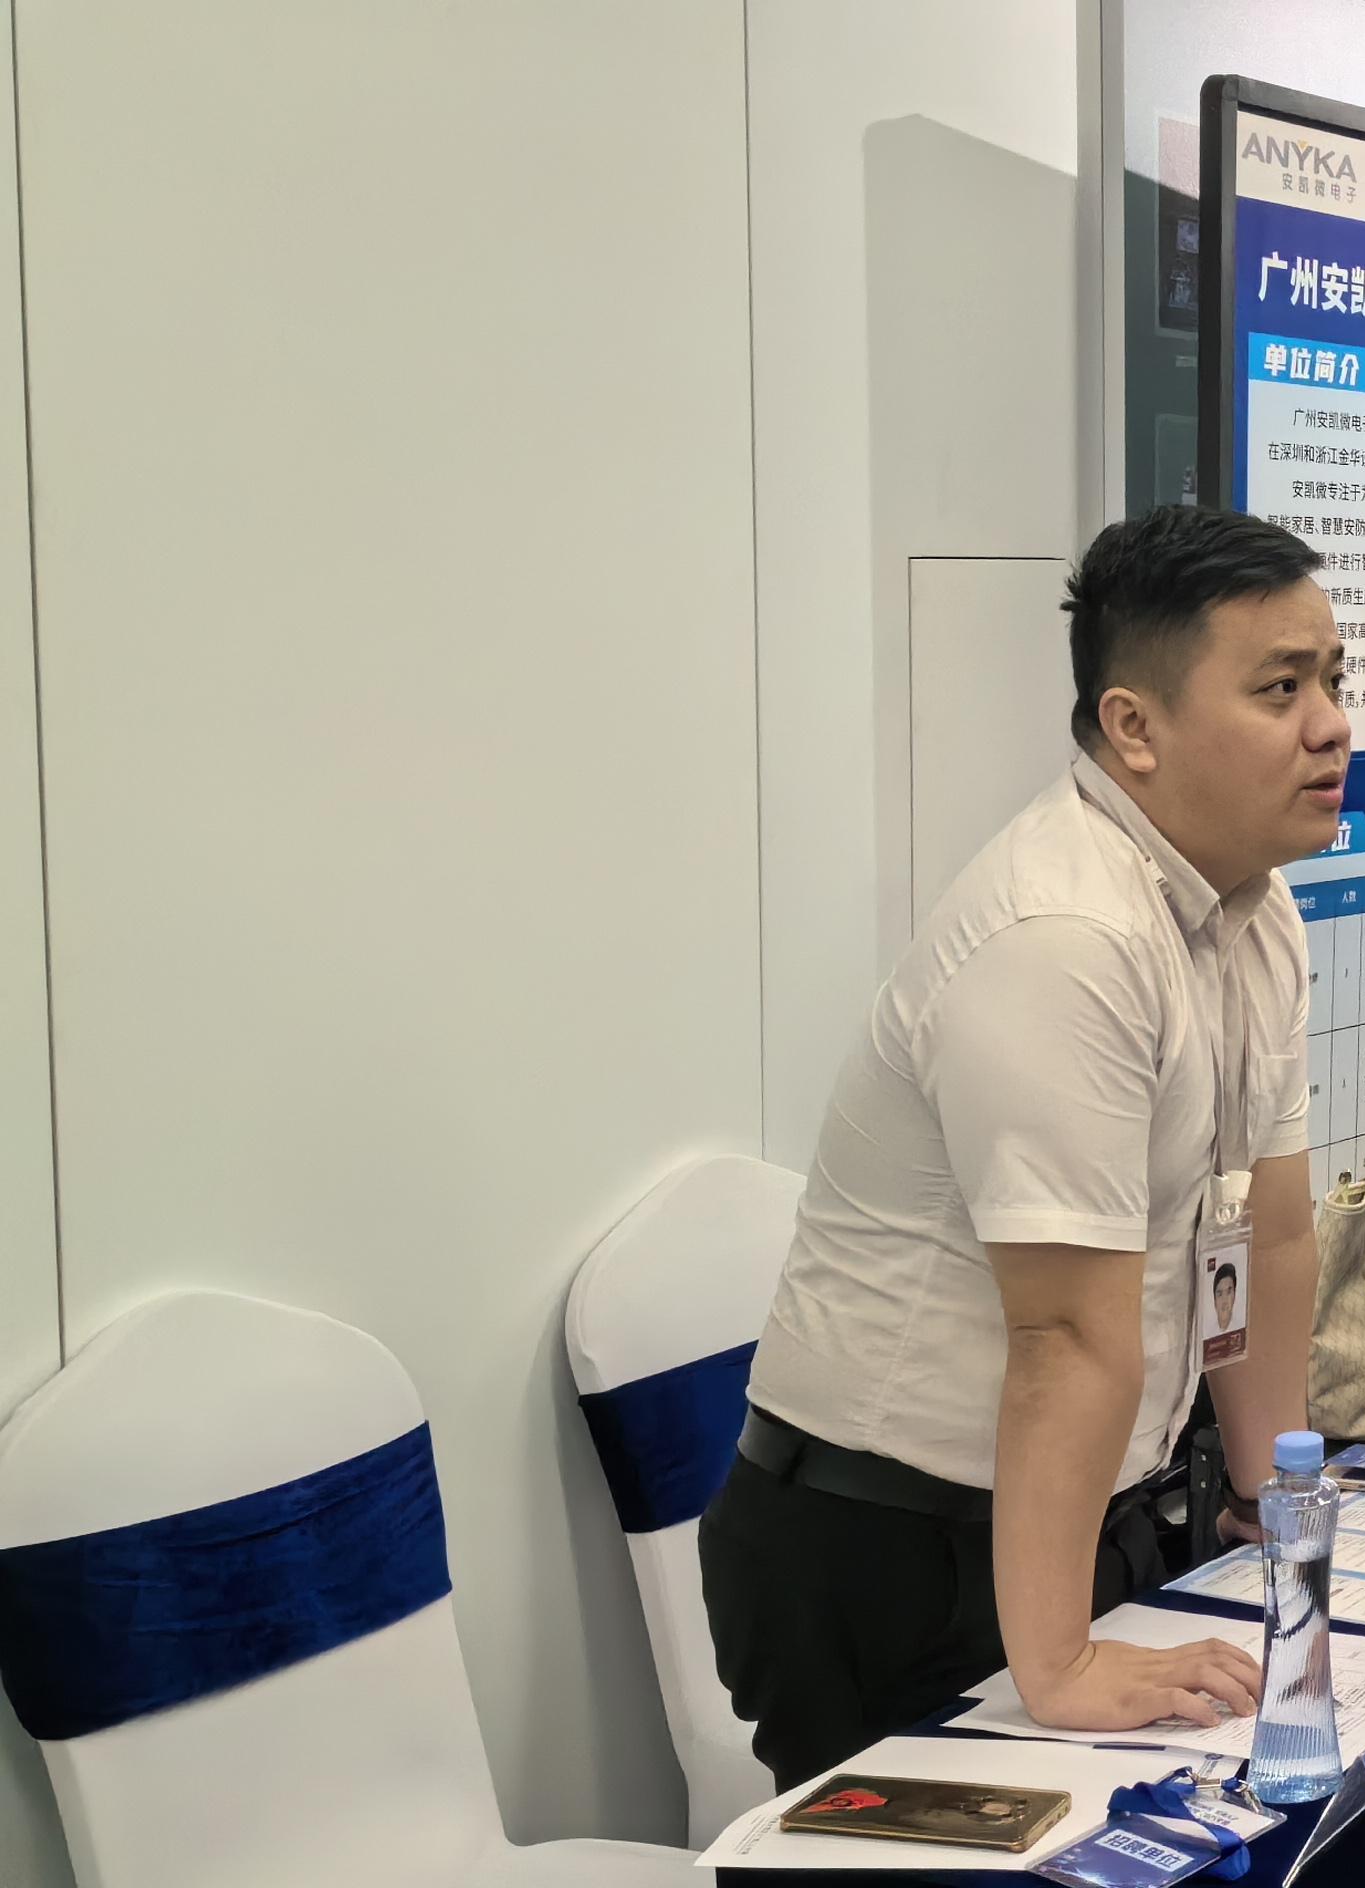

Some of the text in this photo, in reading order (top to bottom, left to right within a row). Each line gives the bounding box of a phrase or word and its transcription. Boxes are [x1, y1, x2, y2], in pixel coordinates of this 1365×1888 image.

[1242, 132, 1357, 183] ANYKA
[1282, 172, 1357, 204] 安凯微电子
[1264, 343, 1360, 386] 单位简介
[1104, 1833, 1181, 1869] 招聘单位
